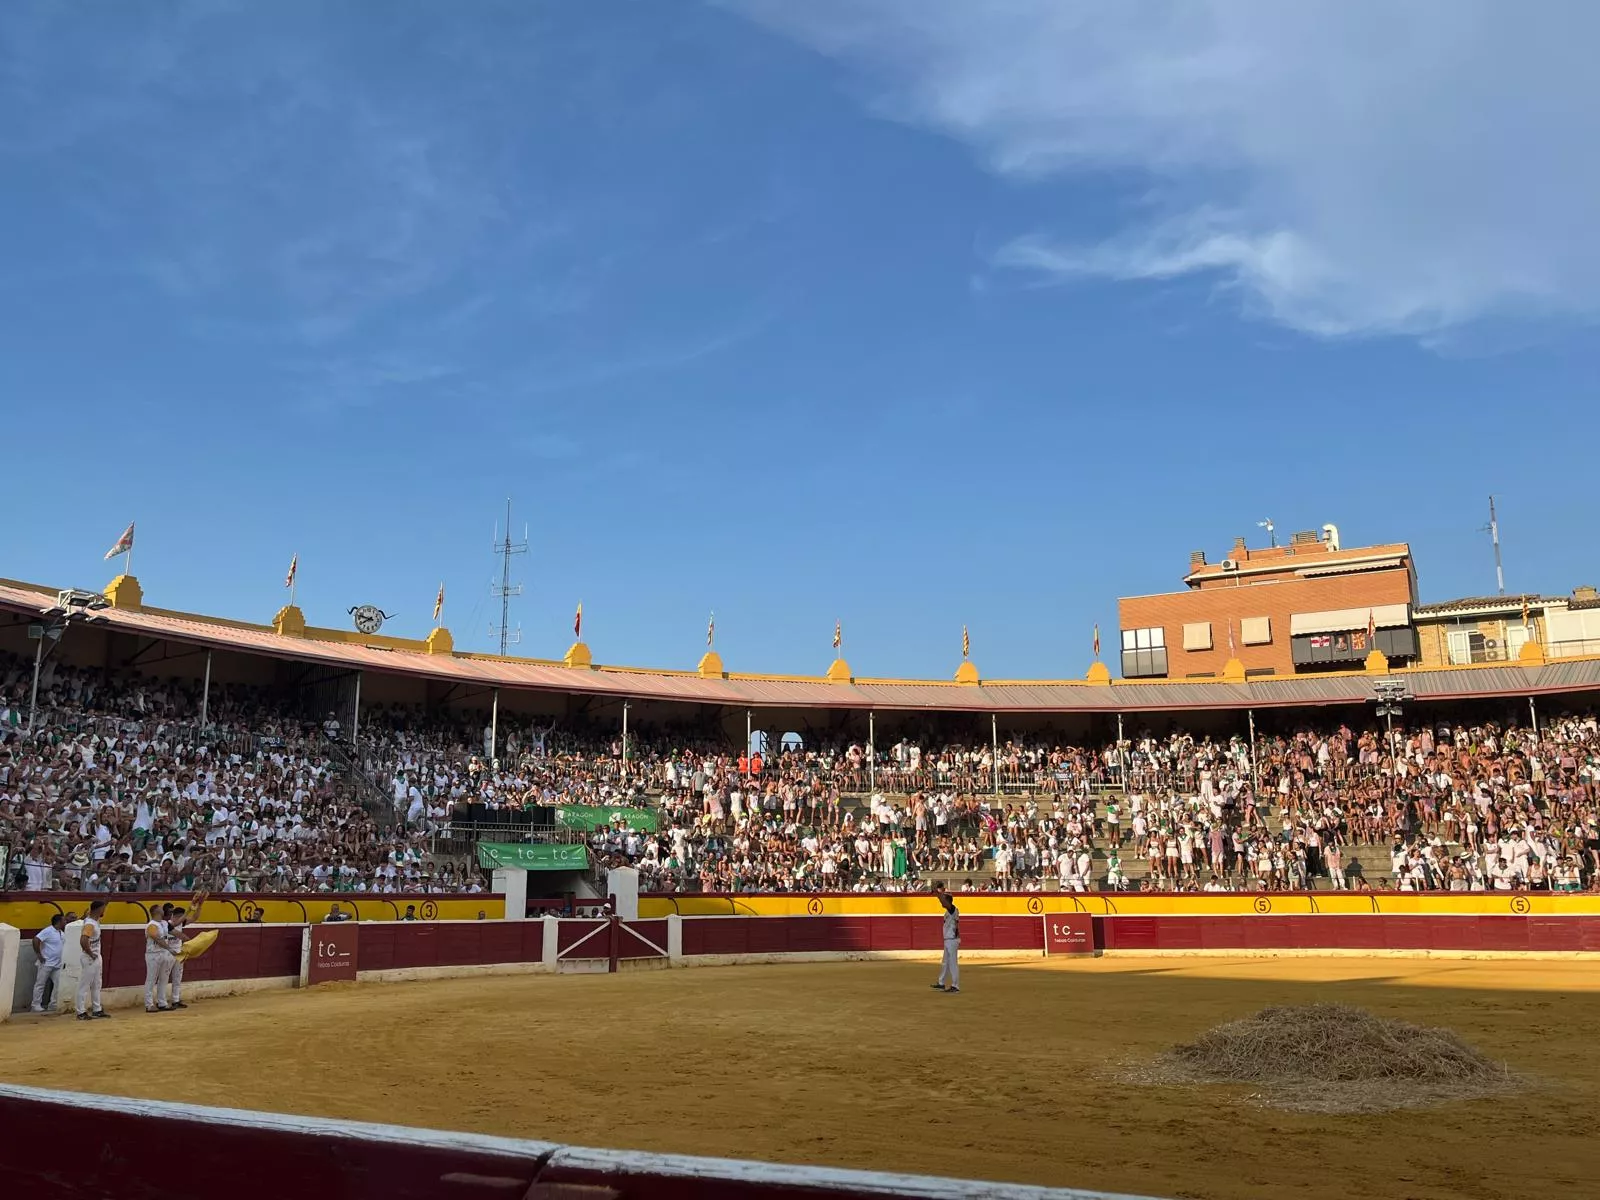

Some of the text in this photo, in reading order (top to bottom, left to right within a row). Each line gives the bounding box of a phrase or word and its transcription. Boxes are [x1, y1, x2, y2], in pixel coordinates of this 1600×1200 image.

[425, 904, 433, 918] 3
[812, 901, 818, 913] 4
[1031, 900, 1038, 912] 4
[1259, 900, 1267, 912] 5
[1516, 900, 1525, 912] 5
[244, 905, 253, 921] 3
